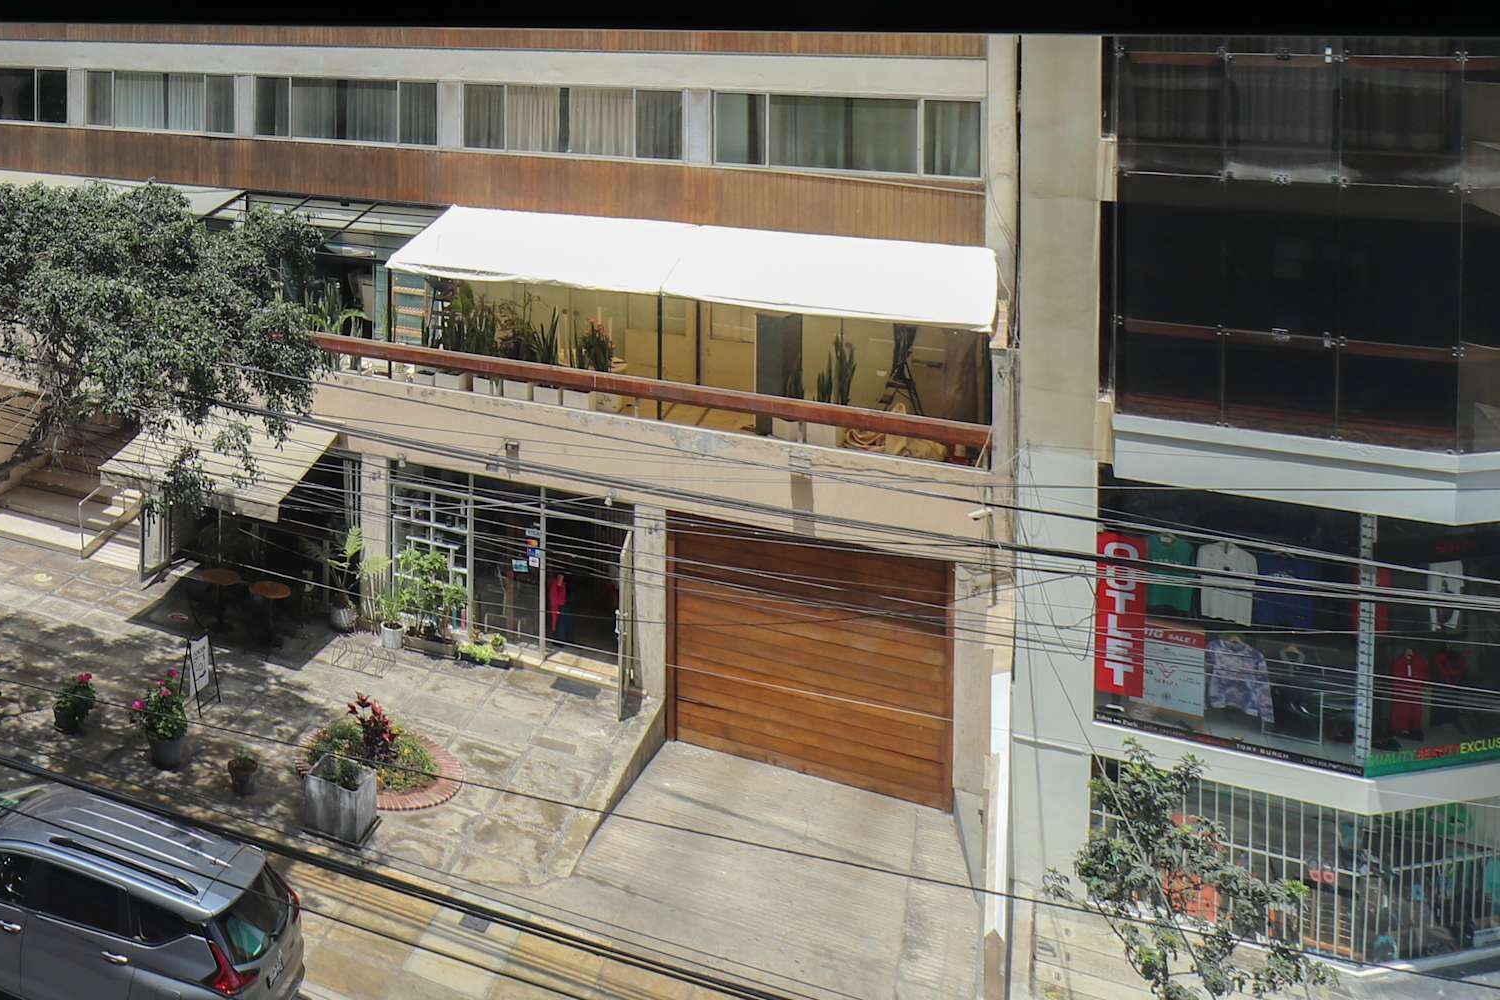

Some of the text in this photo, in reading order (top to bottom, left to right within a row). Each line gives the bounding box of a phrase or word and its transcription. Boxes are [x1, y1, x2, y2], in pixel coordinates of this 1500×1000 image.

[1103, 542, 1139, 686] OUTLET
[1236, 742, 1256, 752] TORY
[1460, 736, 1500, 754] EXCLUS
